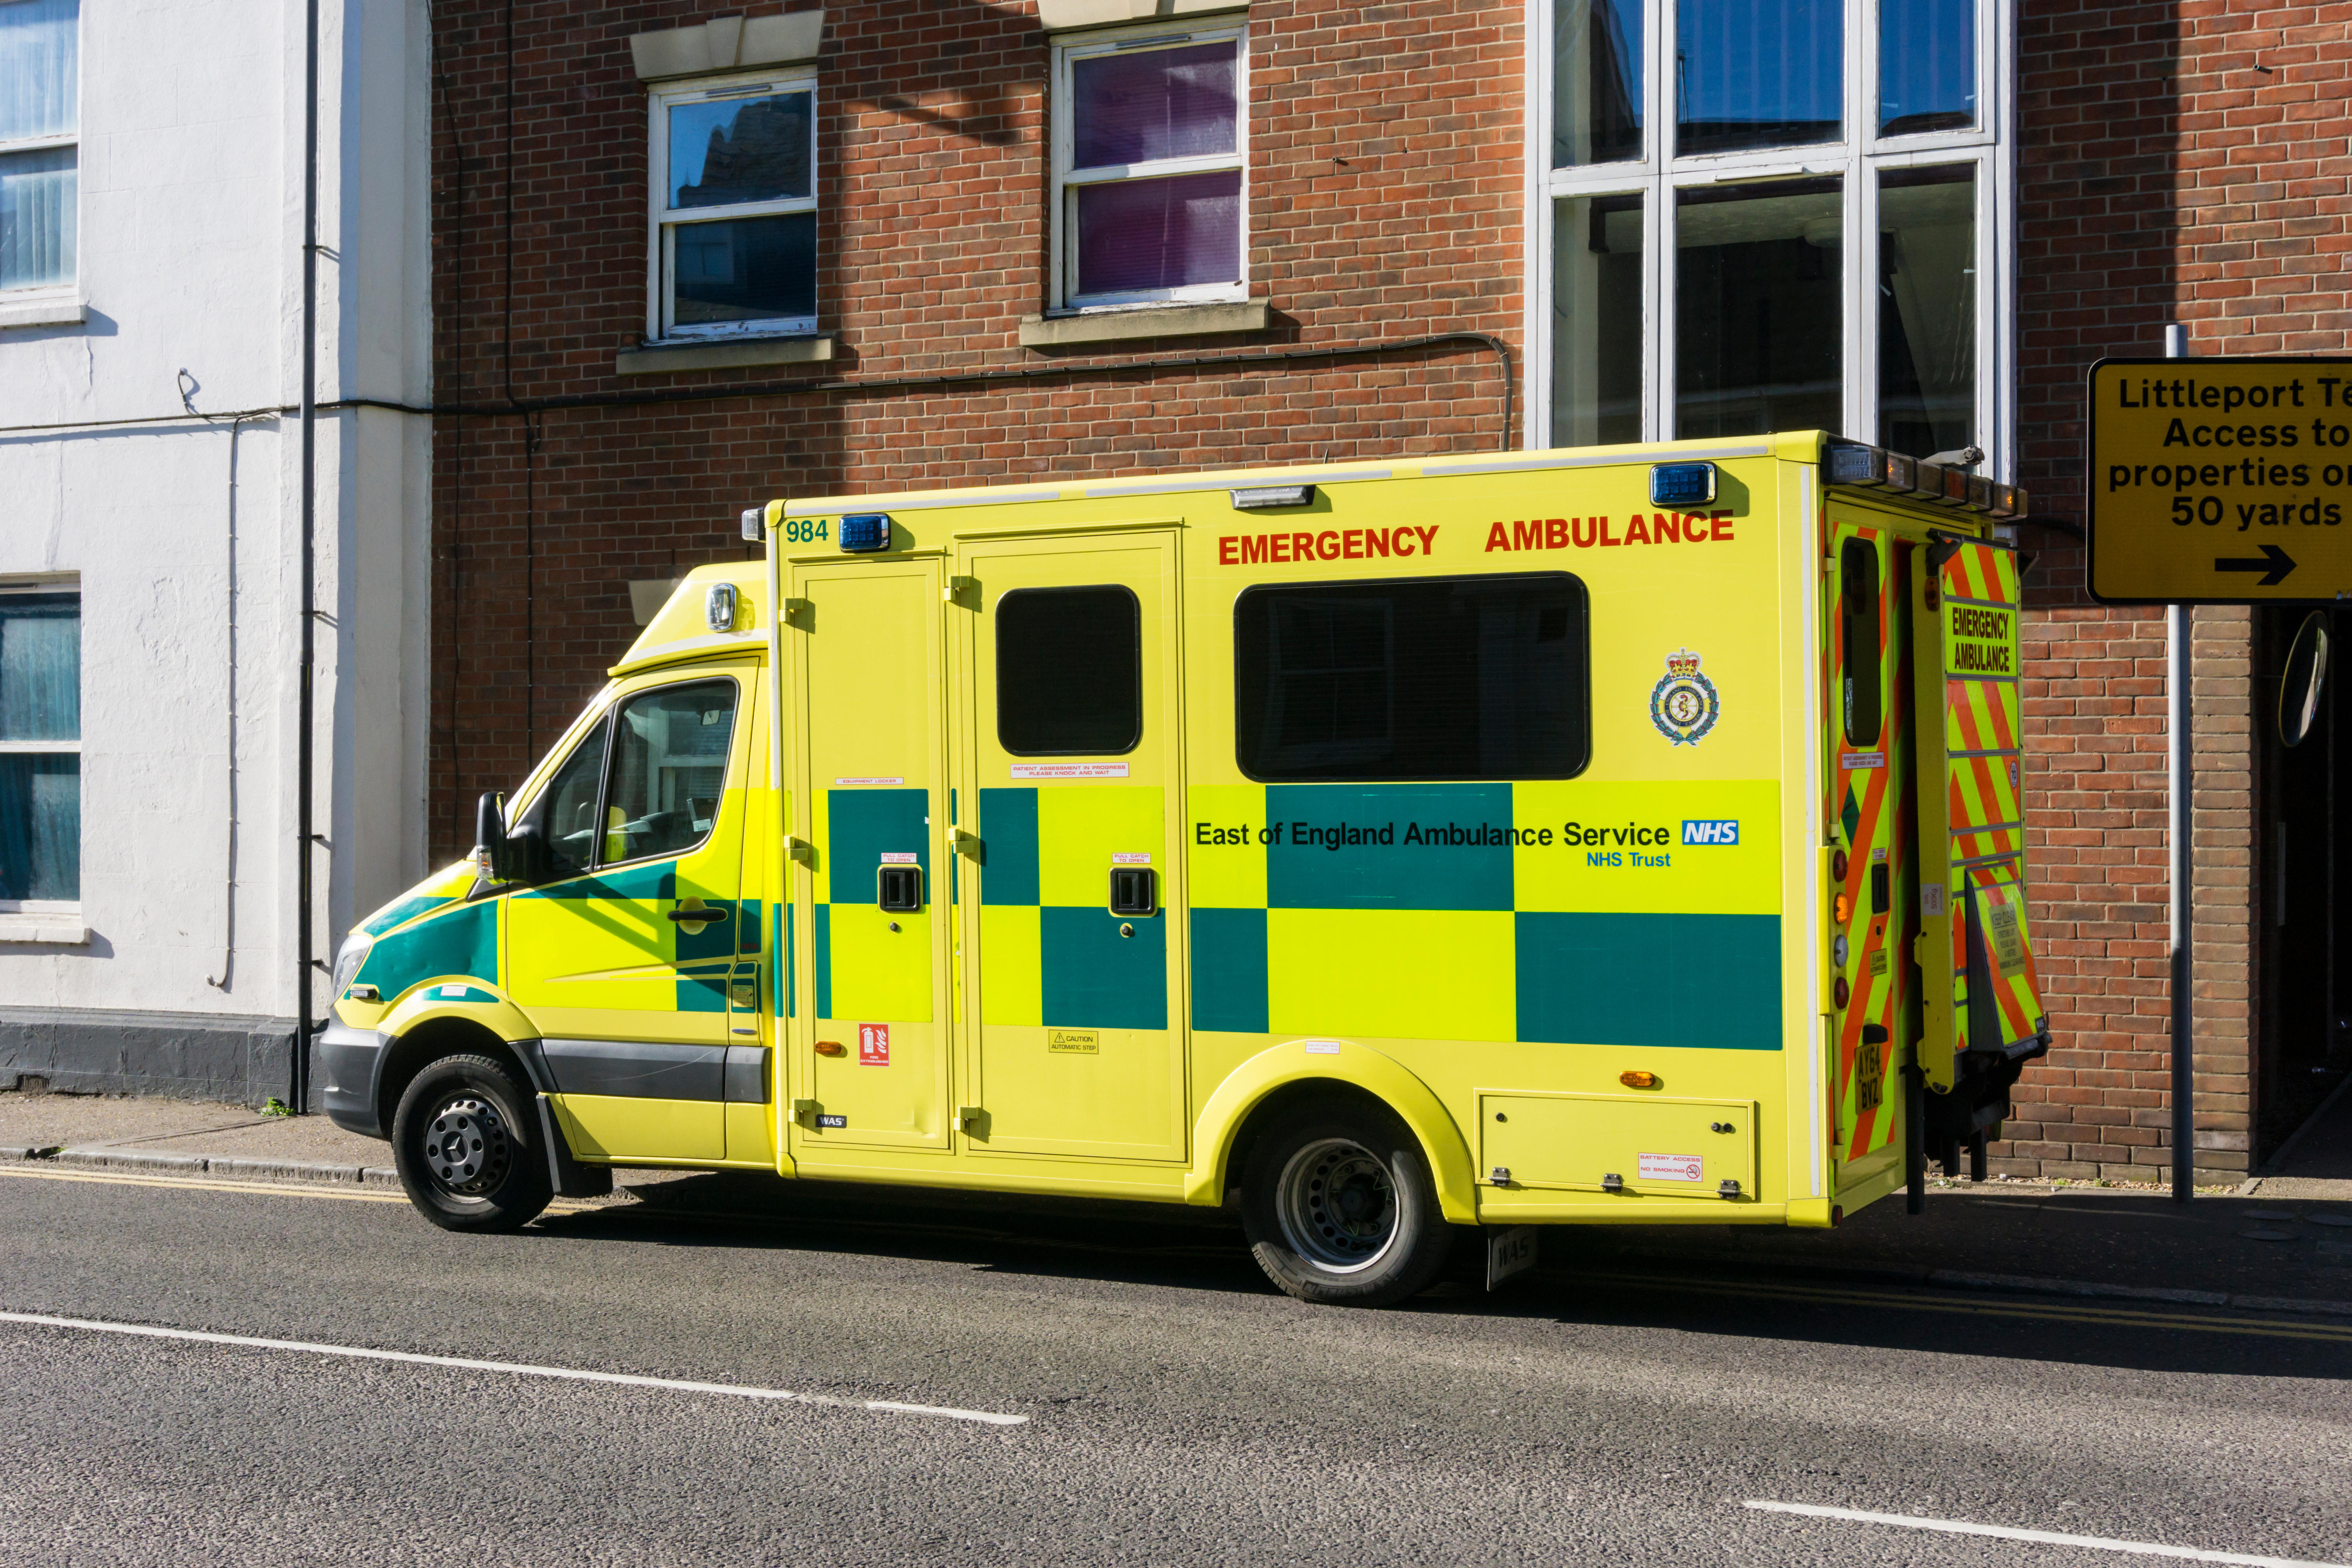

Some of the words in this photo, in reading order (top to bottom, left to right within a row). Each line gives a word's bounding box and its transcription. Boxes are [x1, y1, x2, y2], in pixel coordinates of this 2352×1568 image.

[2120, 379, 2304, 413] Littleport
[2163, 418, 2298, 447] Access
[2312, 418, 2350, 447] to
[2109, 457, 2310, 492] properties
[2323, 464, 2352, 486] o
[2172, 496, 2223, 526] 50
[2236, 497, 2341, 532] yards
[786, 519, 829, 543] 984
[1218, 525, 1440, 565] EMERGENCY
[1484, 510, 1735, 552] AMBULANCE
[1952, 607, 2009, 640] EMERGENCY
[1955, 642, 2010, 672] AMBULANCE
[1685, 687, 1703, 709] AMBULANCE
[1196, 822, 1250, 845] East
[1258, 822, 1283, 845] of
[1292, 822, 1393, 851] England
[1403, 822, 1553, 846] Ambulance
[1564, 822, 1670, 846] Service
[1684, 822, 1737, 844] NHS
[1587, 852, 1622, 867] NHS
[1629, 852, 1671, 867] Trust
[1858, 1044, 1880, 1077] AY64
[1862, 1077, 1878, 1109] BVZ
[820, 1117, 842, 1126] WAS
